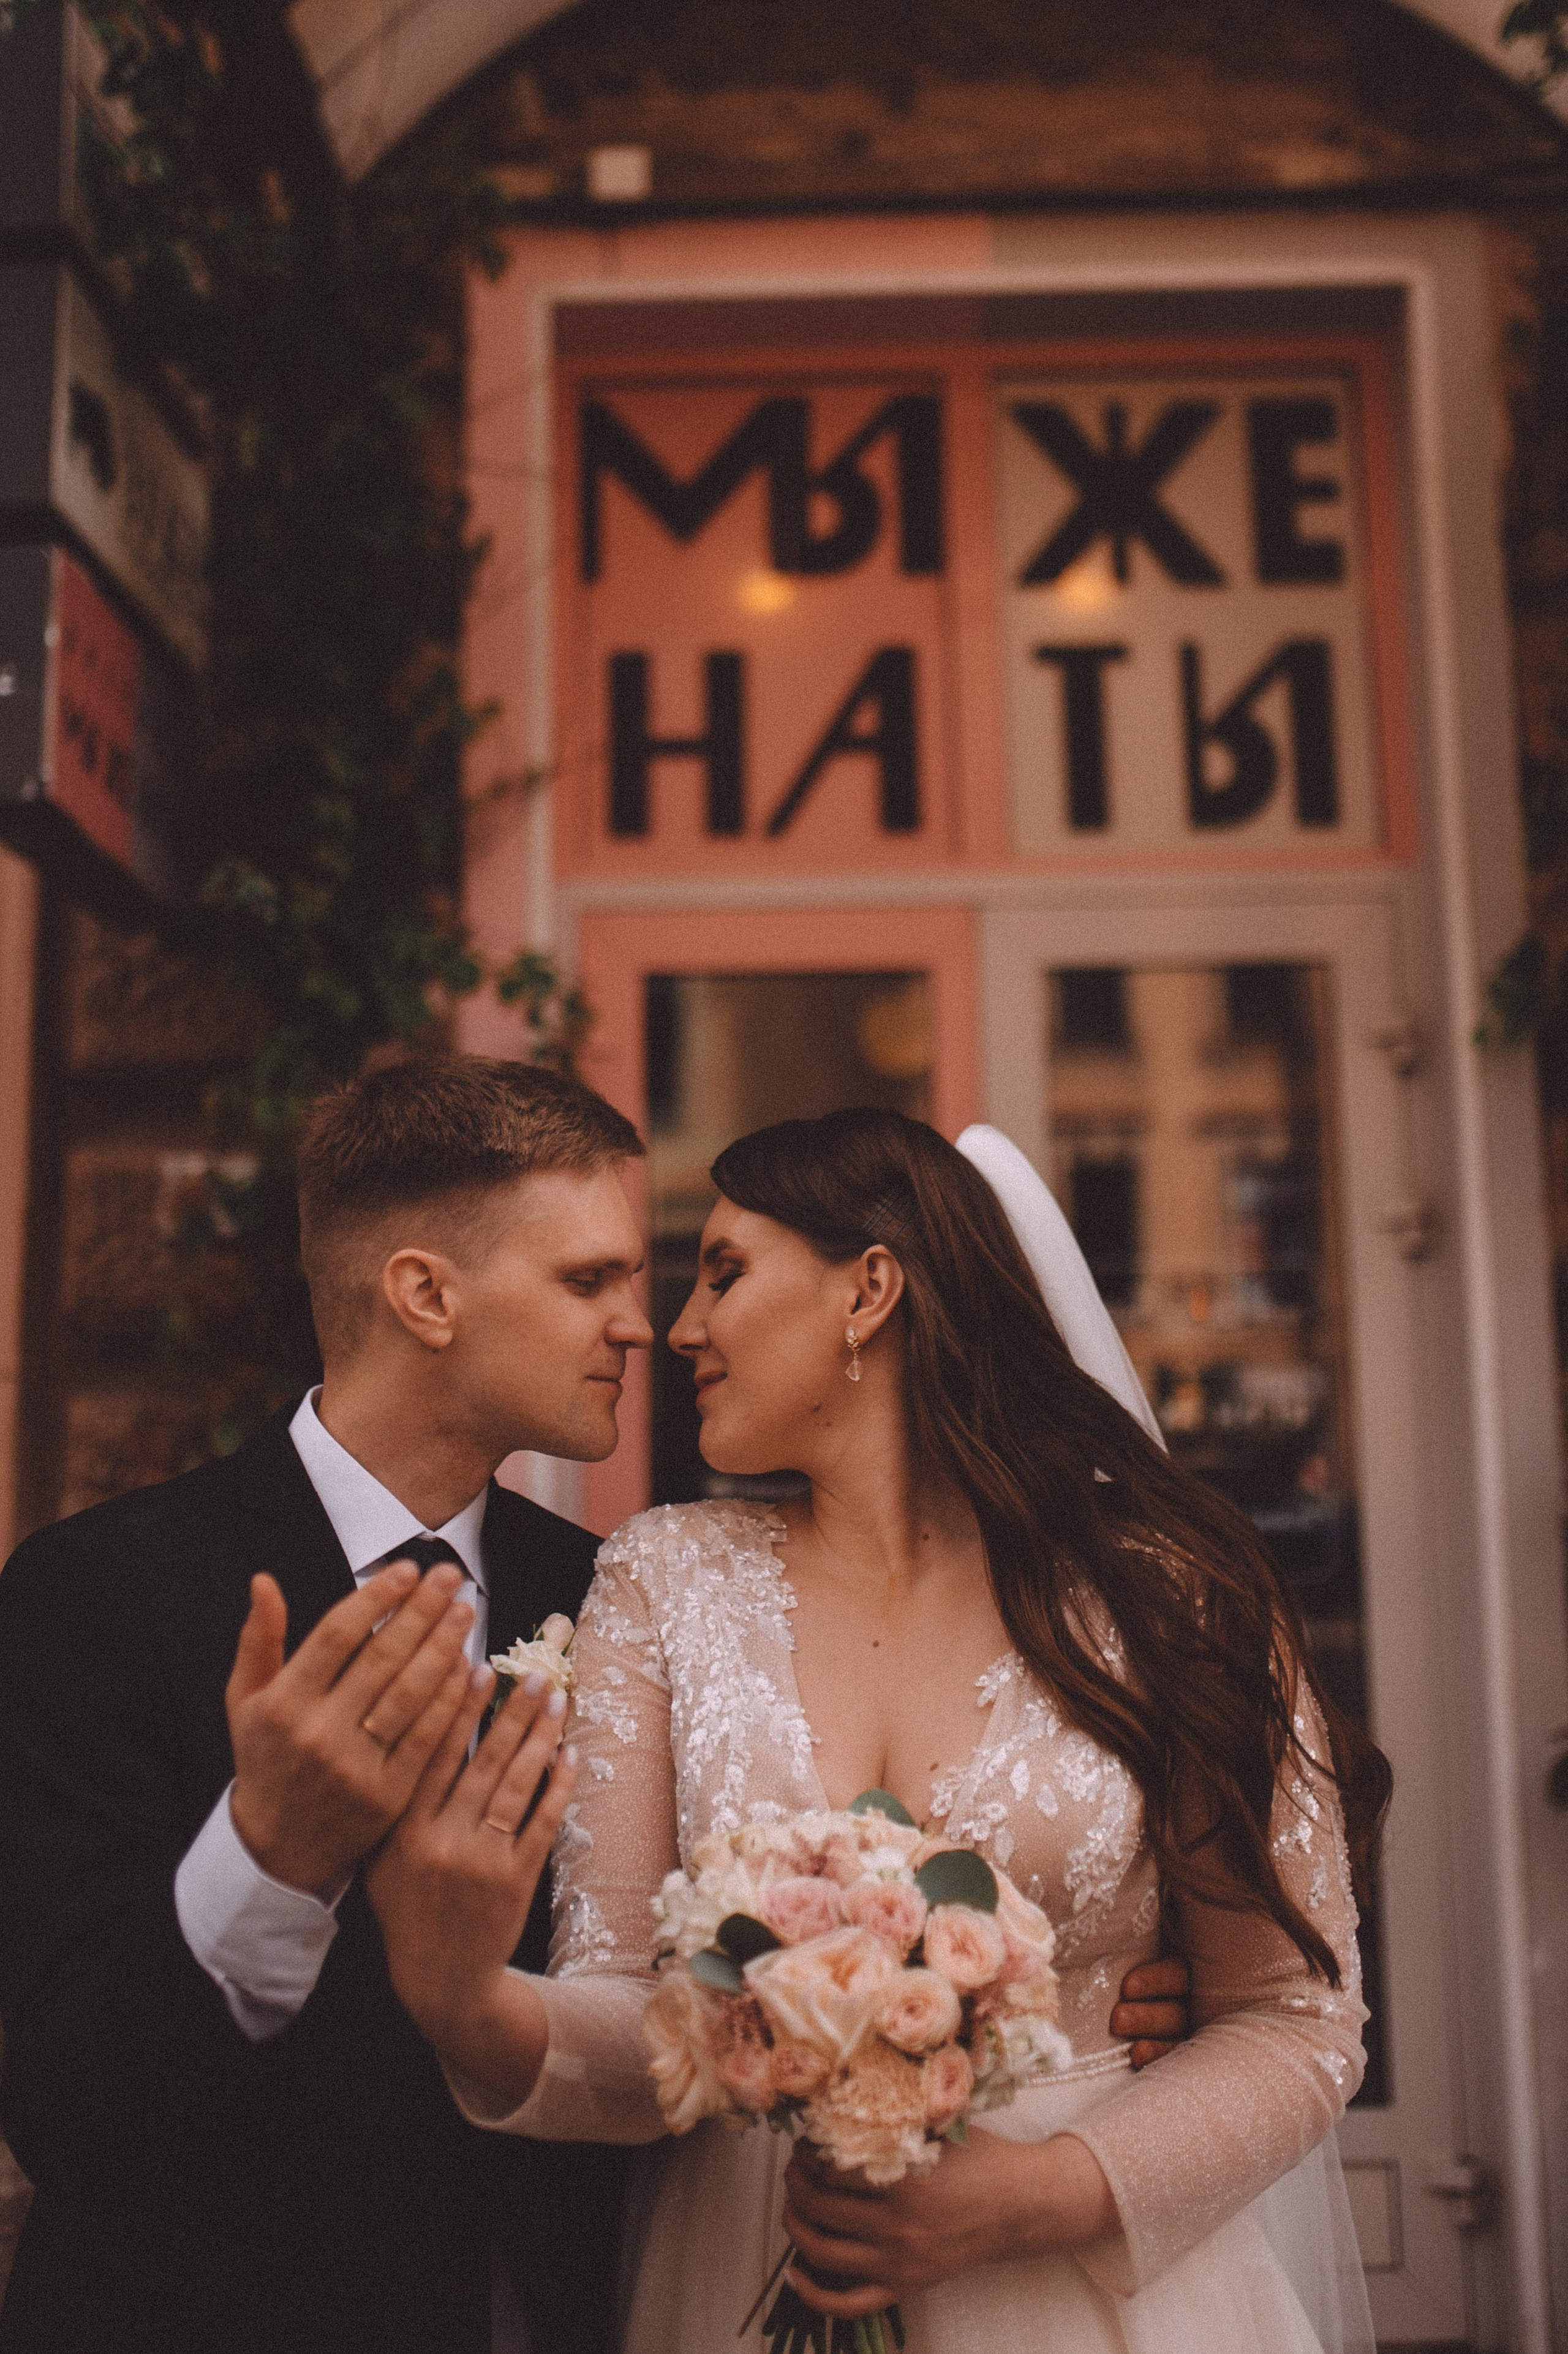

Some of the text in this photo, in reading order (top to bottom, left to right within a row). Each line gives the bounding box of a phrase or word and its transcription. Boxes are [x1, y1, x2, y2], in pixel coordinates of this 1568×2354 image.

[578, 396, 1345, 588] МЫ ЖЕ
[608, 637, 1340, 839] НА ТЫ
